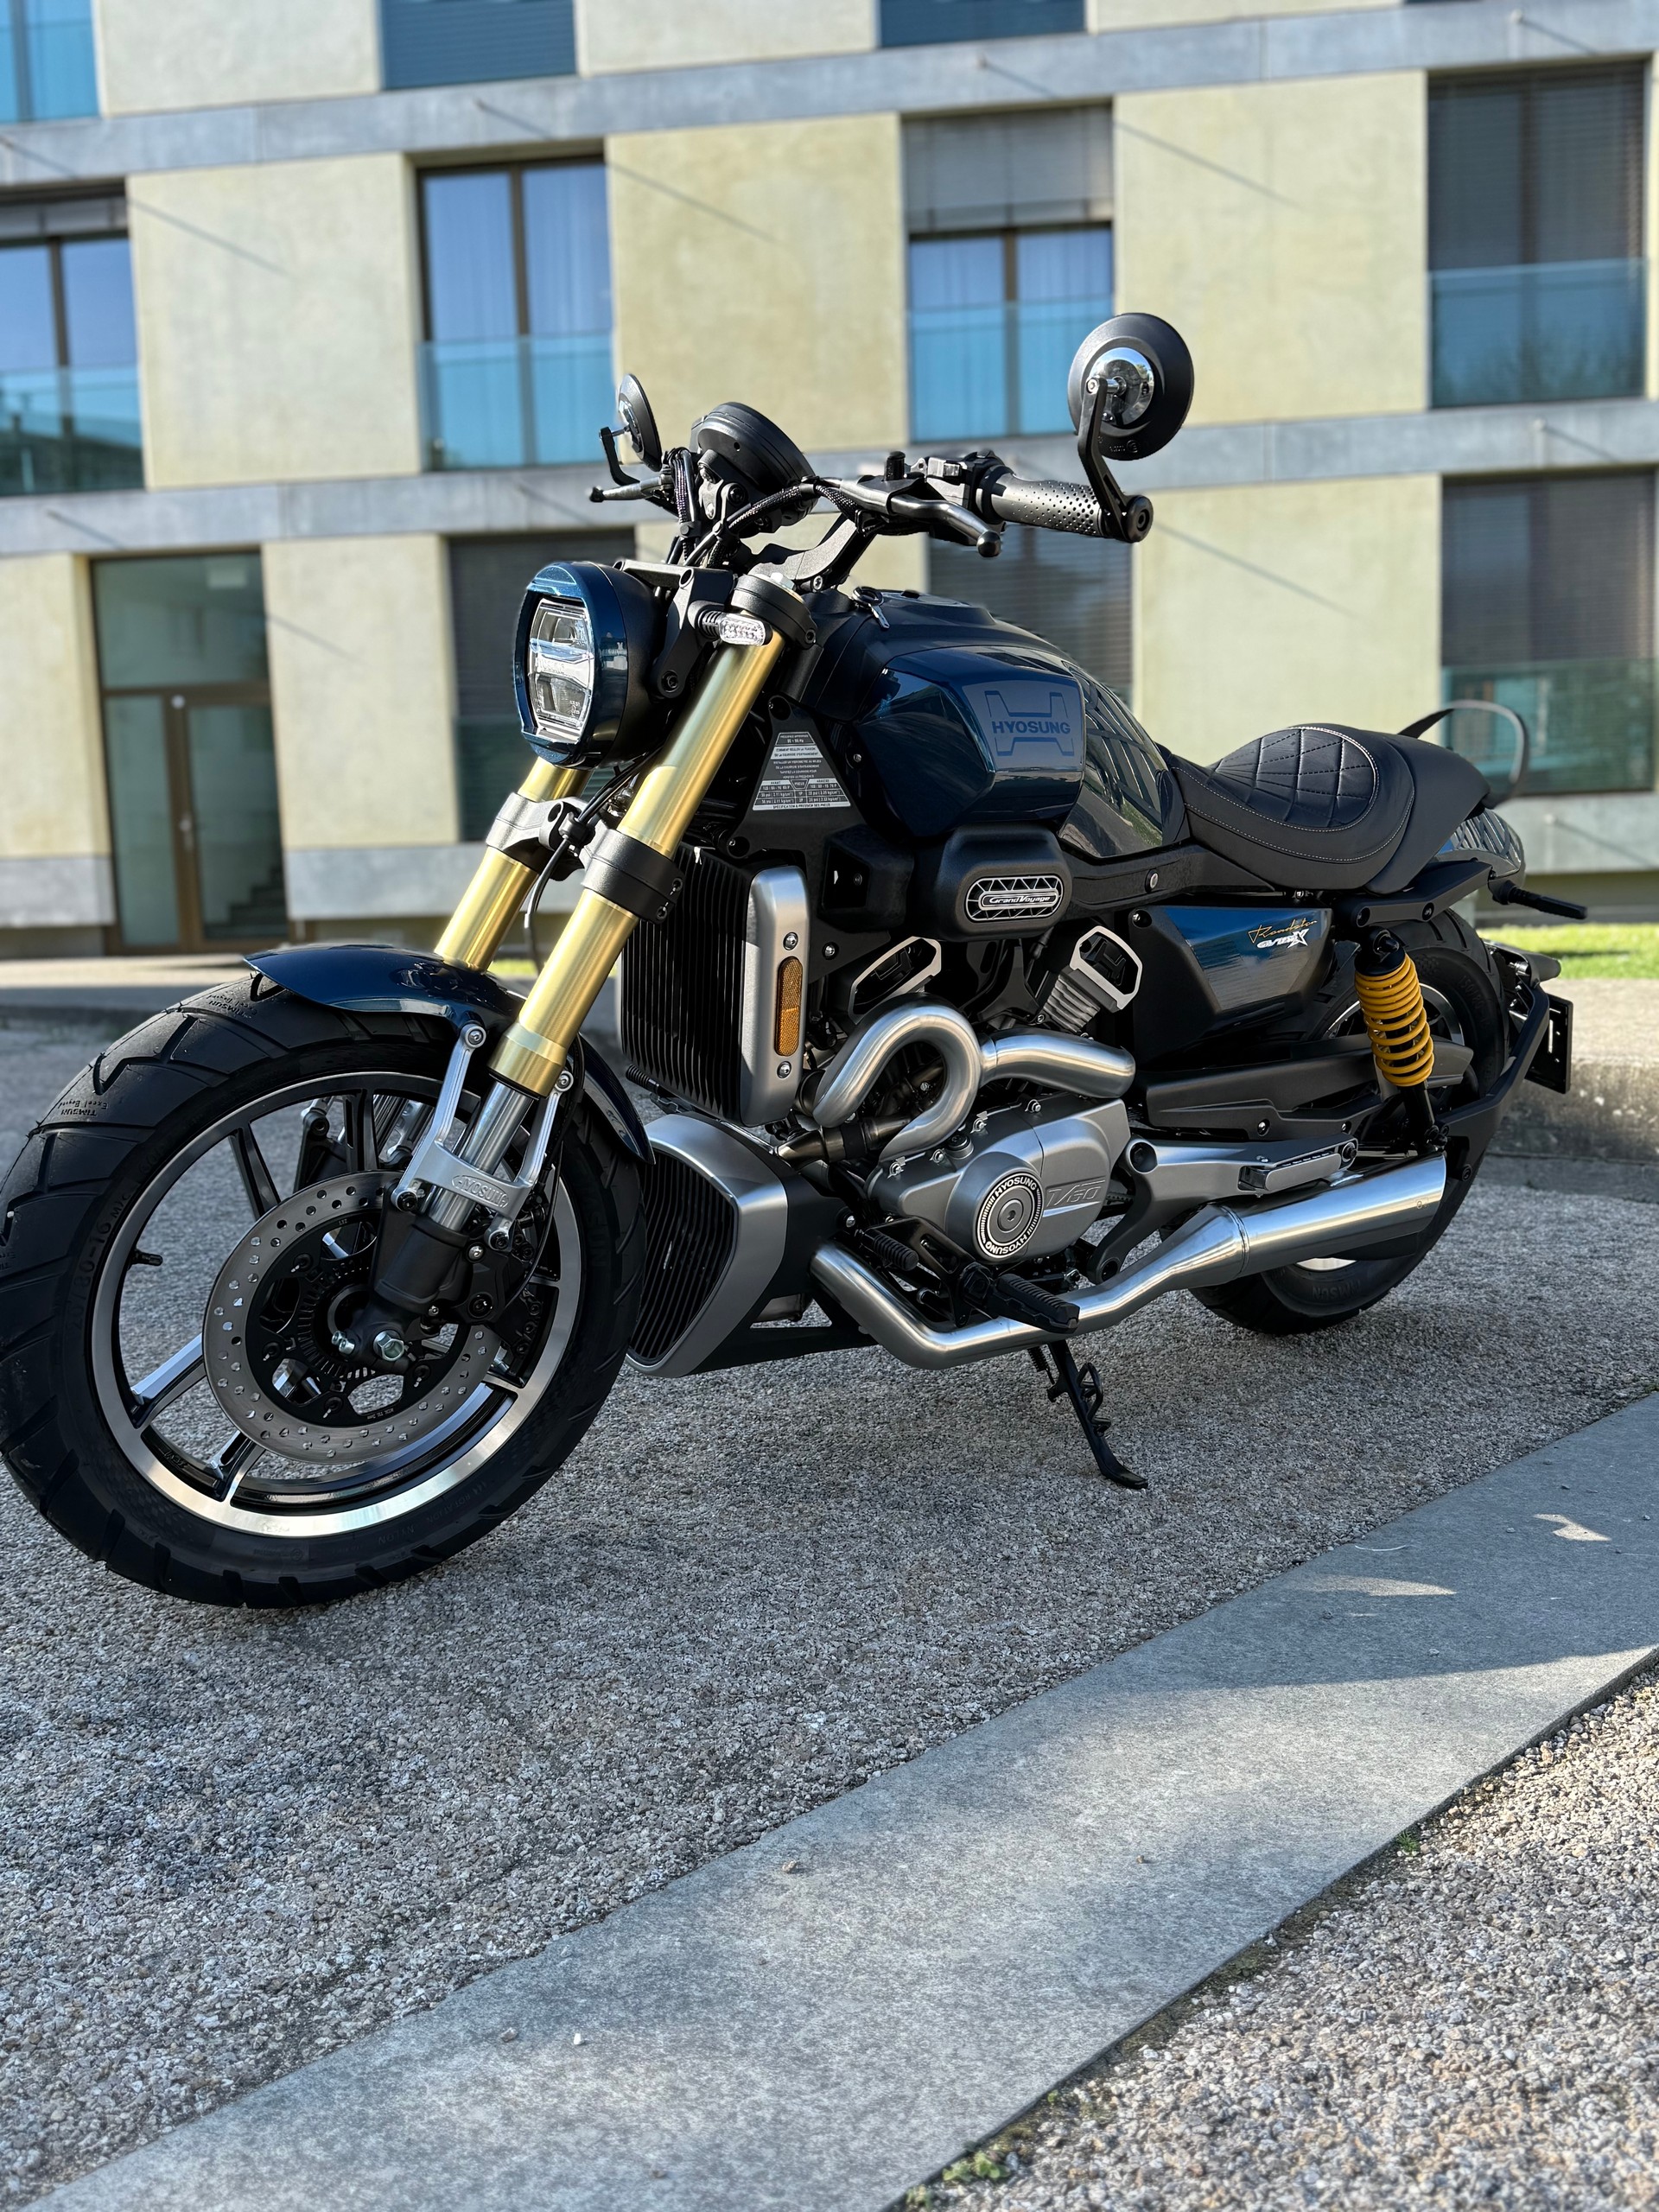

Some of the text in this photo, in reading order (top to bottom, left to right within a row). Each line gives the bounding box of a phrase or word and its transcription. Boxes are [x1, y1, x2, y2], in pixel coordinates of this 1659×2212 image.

[991, 721, 1071, 734] HYOSUNG
[60, 1108, 97, 1116] TIMSUN
[995, 1176, 1037, 1198] HYOSUNG
[985, 1234, 1028, 1255] HYOSUNG
